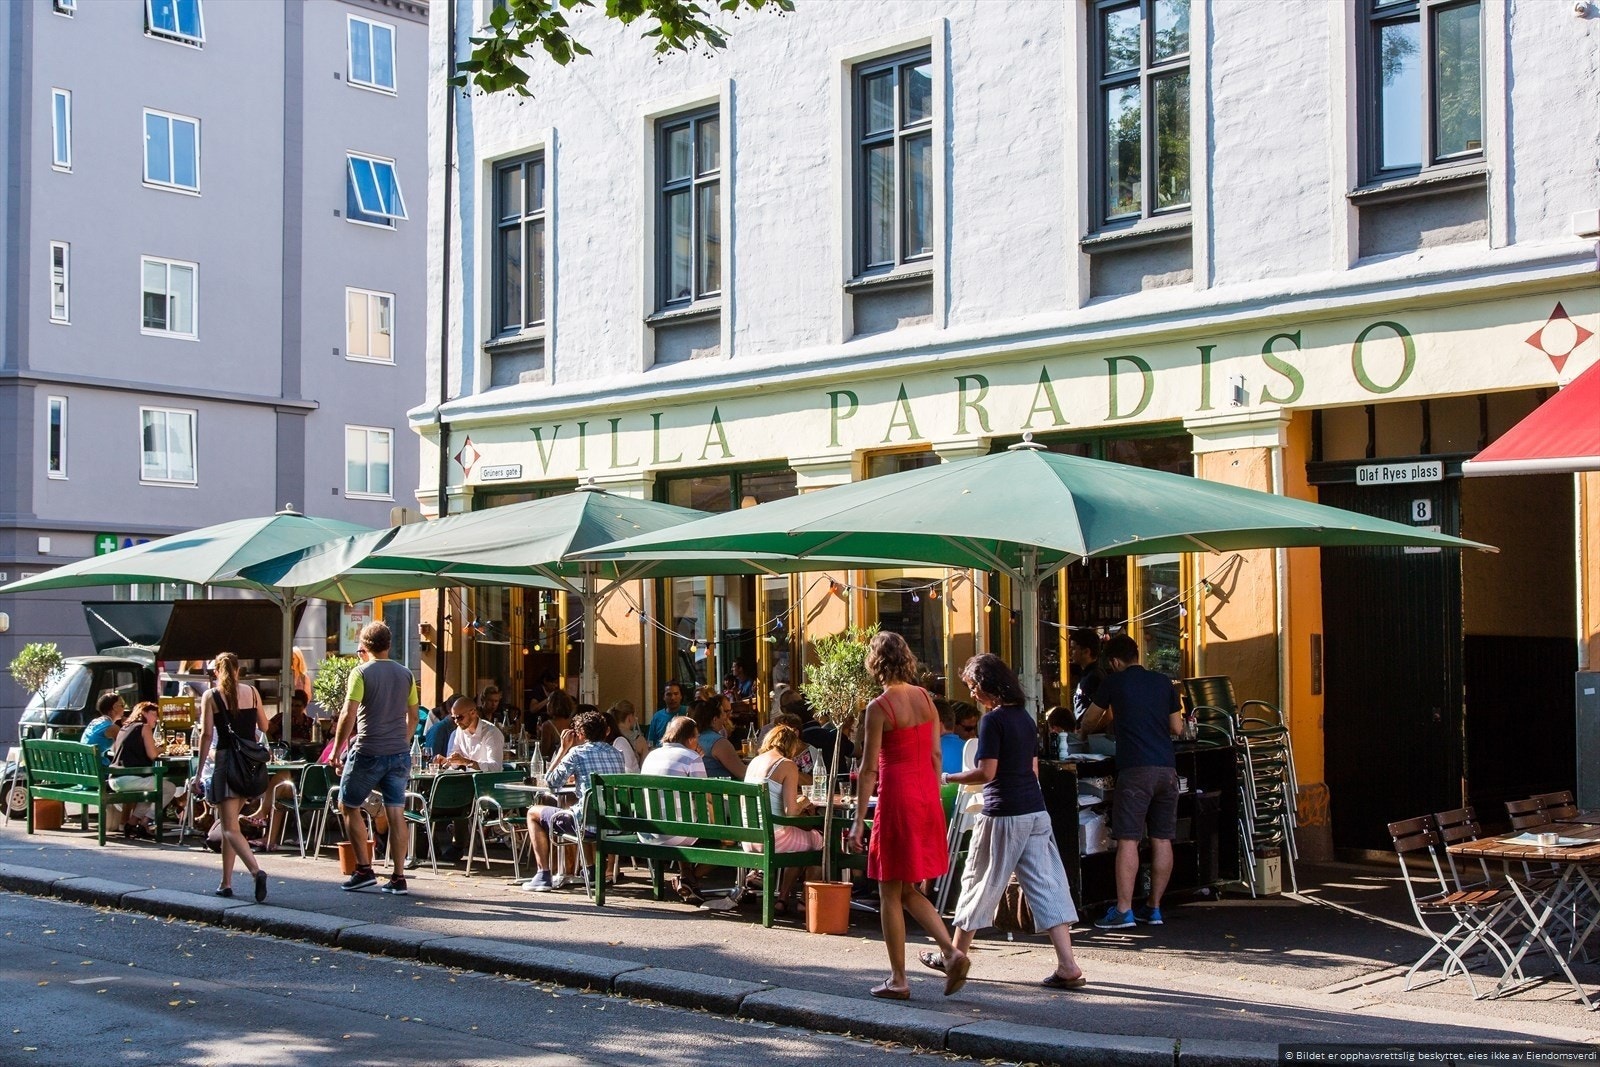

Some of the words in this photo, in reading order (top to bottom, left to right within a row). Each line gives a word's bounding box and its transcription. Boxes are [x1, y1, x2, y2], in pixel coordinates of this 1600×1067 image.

[529, 405, 734, 476] VILLA
[825, 321, 1416, 448] PARADISO
[505, 469, 518, 477] gate
[1359, 468, 1379, 481] Olaf
[1383, 467, 1407, 481] Ryes
[1411, 465, 1438, 480] plass
[1416, 502, 1427, 518] 8
